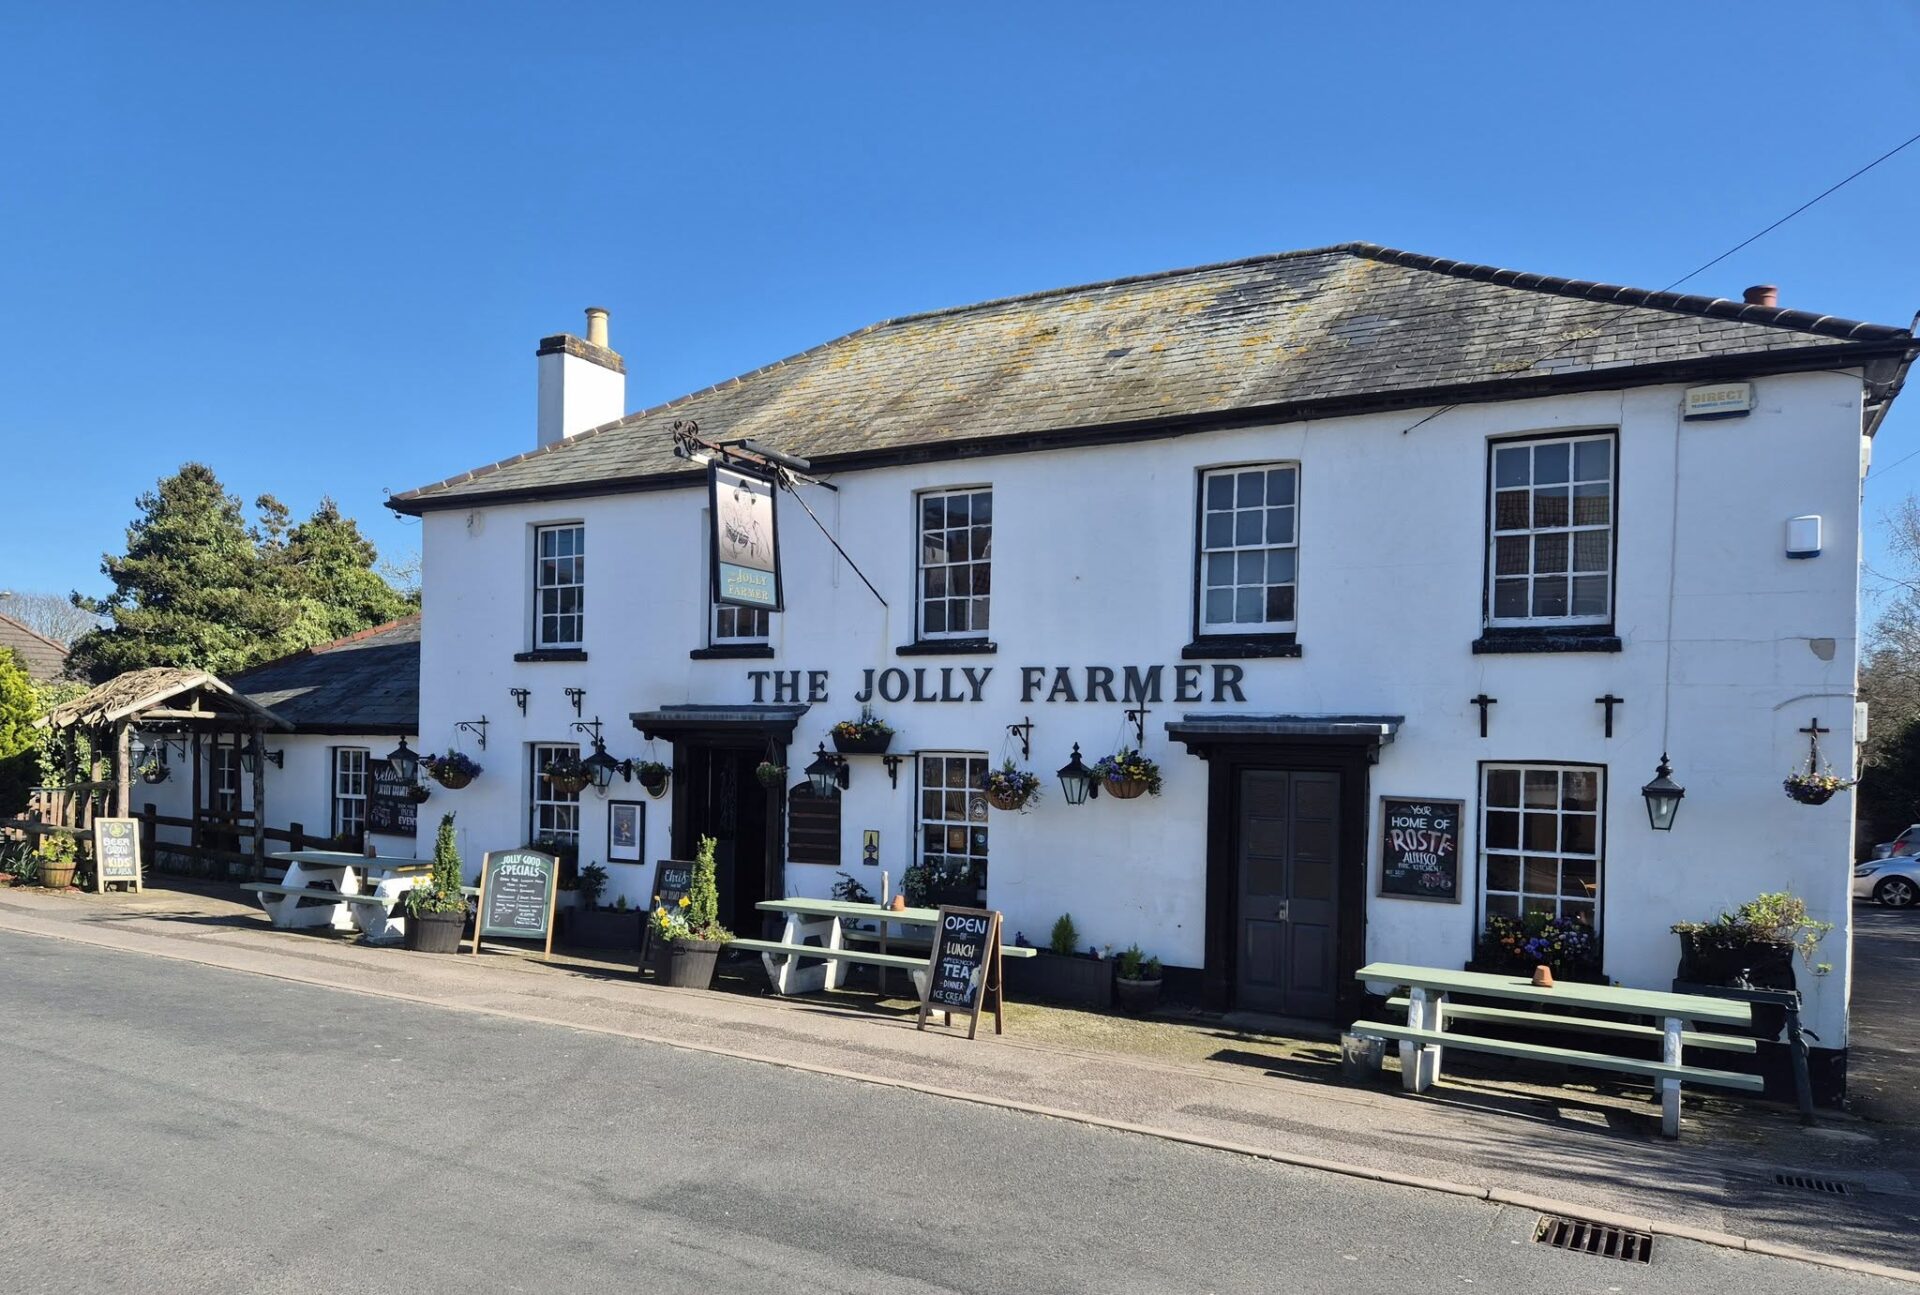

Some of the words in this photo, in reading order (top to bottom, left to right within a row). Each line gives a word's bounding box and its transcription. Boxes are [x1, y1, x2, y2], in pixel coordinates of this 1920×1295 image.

[747, 670, 829, 703] THE
[855, 667, 994, 703] JOLLY
[1020, 664, 1247, 703] FARMER
[1391, 816, 1427, 828] HOME
[1434, 819, 1450, 829] OF
[501, 854, 522, 865] JOLLY
[522, 855, 541, 867] GOOD
[500, 864, 540, 877] SPECIALS
[945, 916, 987, 934] OPEN
[946, 942, 975, 958] LUNCH
[943, 963, 970, 979] TEA
[933, 989, 943, 999] ICE
